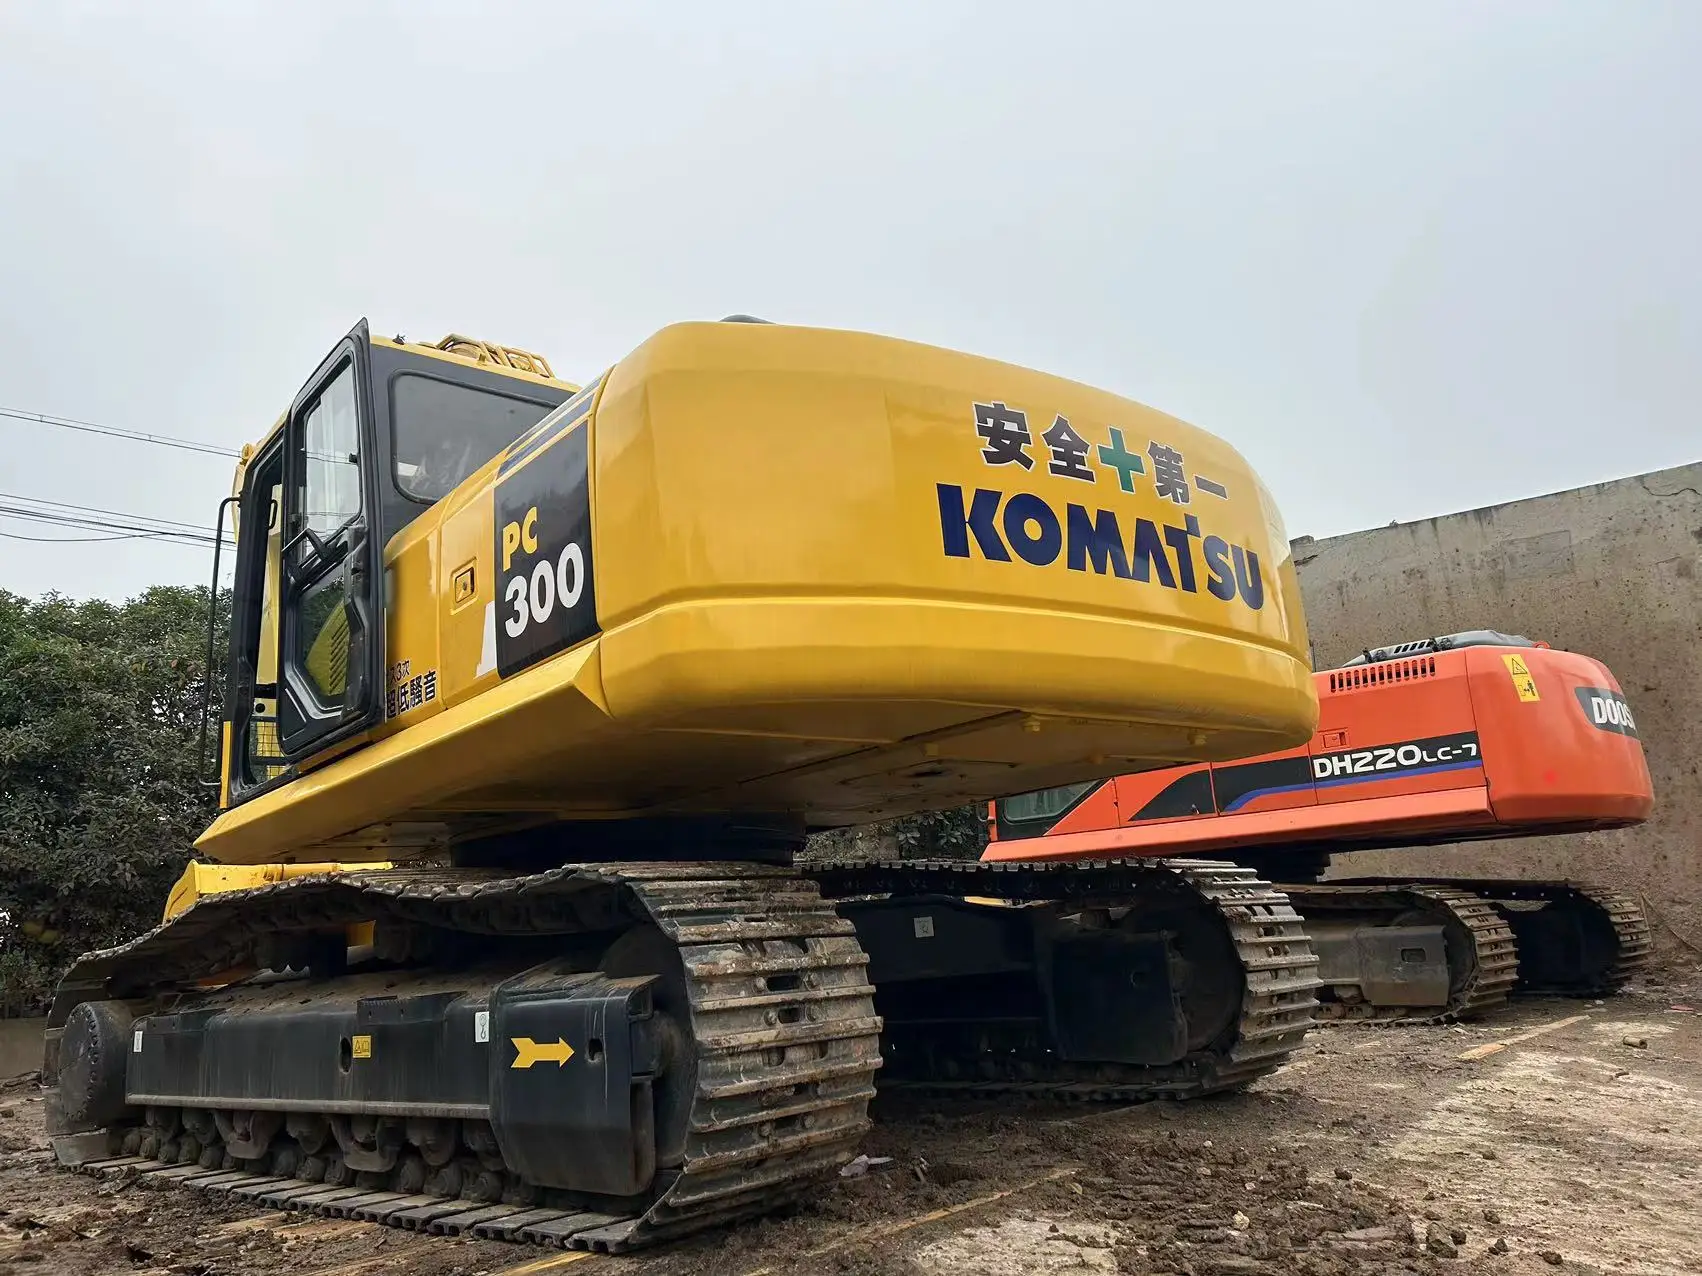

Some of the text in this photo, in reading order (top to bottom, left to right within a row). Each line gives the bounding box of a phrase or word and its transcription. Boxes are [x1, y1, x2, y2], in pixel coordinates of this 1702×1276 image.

[503, 507, 538, 572] PC
[936, 483, 1264, 610] KOMATSU
[505, 542, 585, 638] 300
